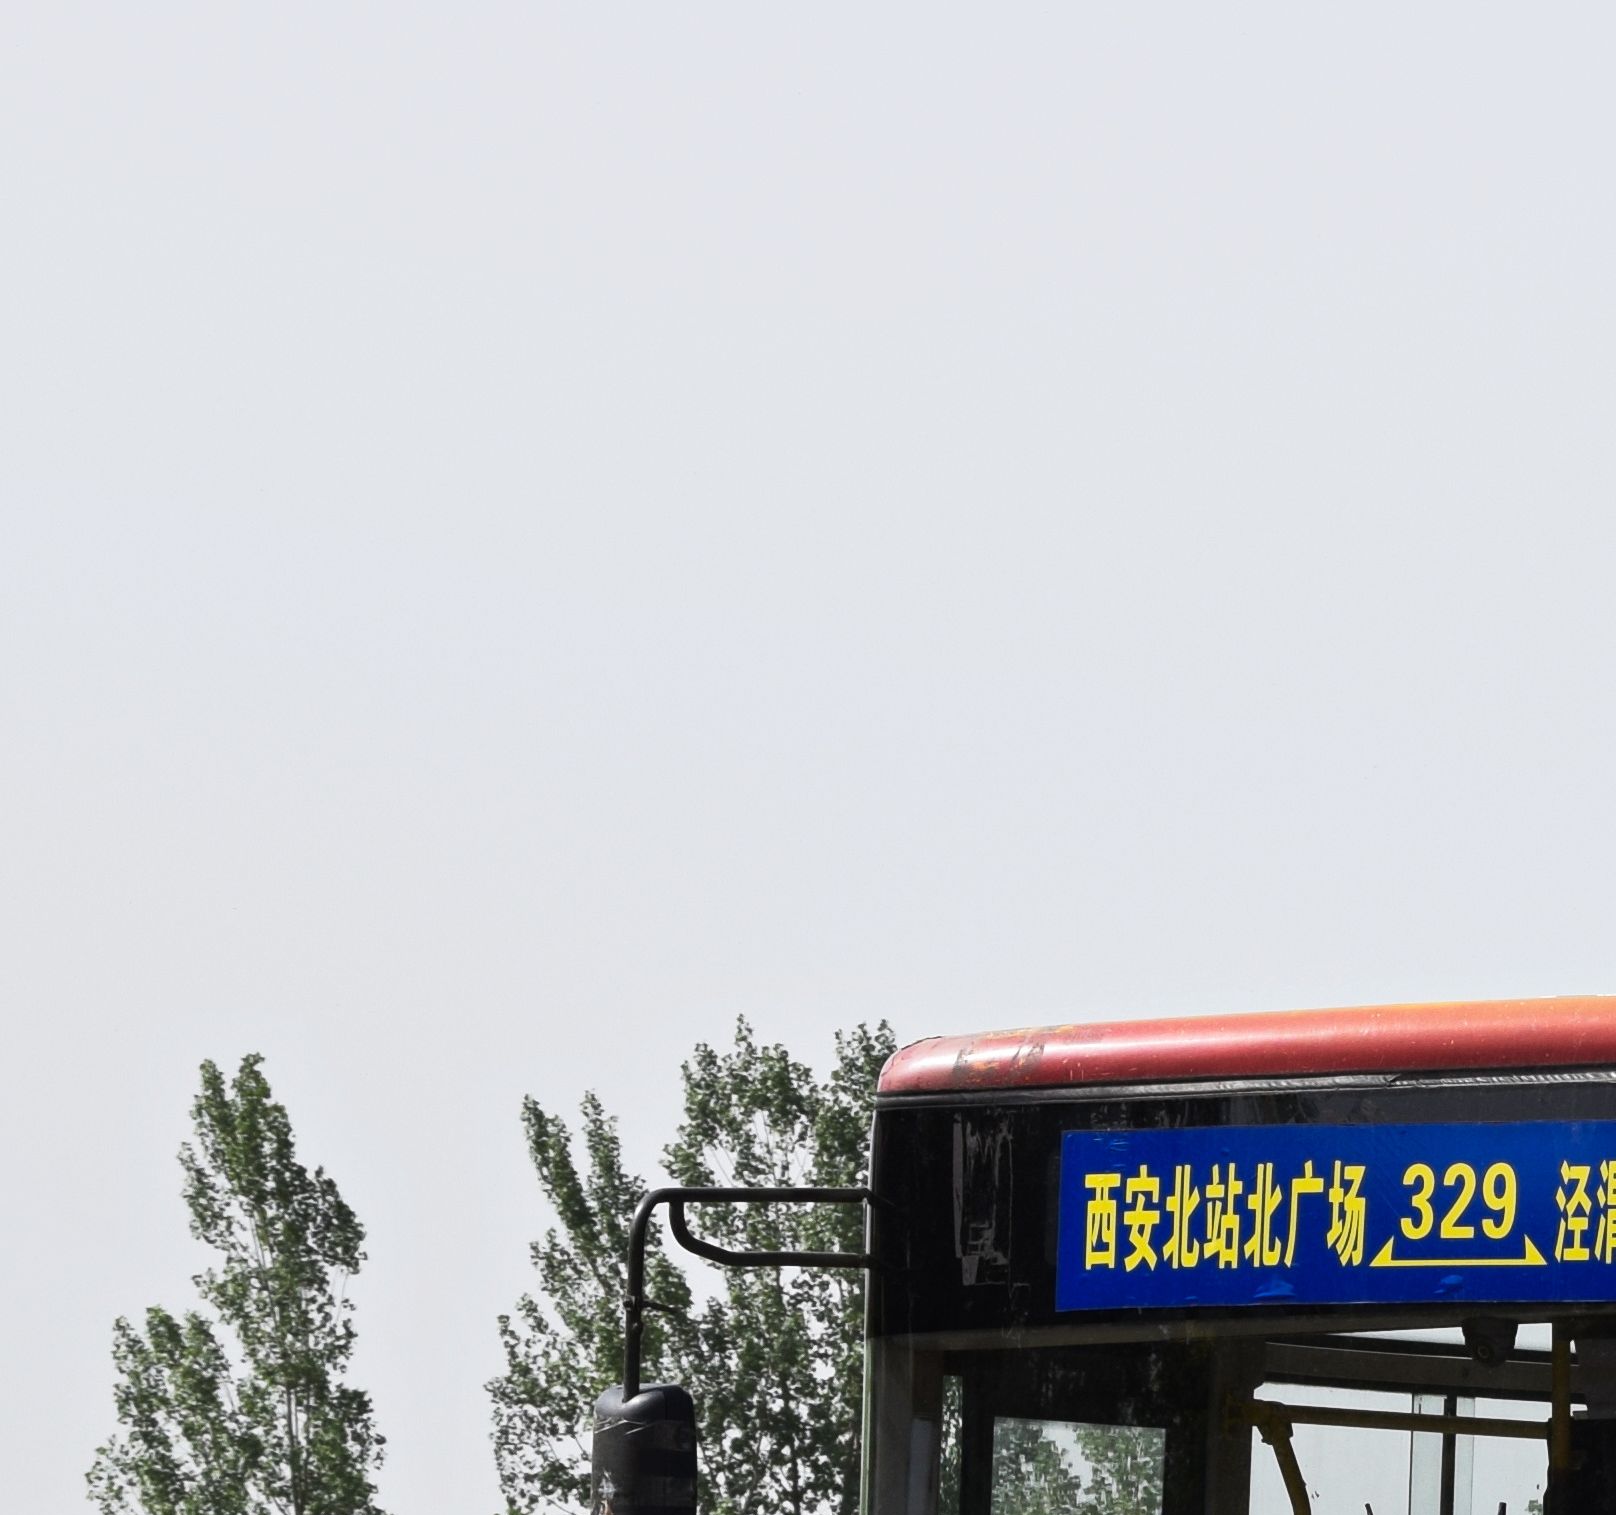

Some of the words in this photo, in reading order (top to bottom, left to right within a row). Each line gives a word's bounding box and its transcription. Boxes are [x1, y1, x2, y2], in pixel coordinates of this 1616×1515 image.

[1084, 1160, 1365, 1270] 西安北站北广场
[1400, 1162, 1518, 1240] 329
